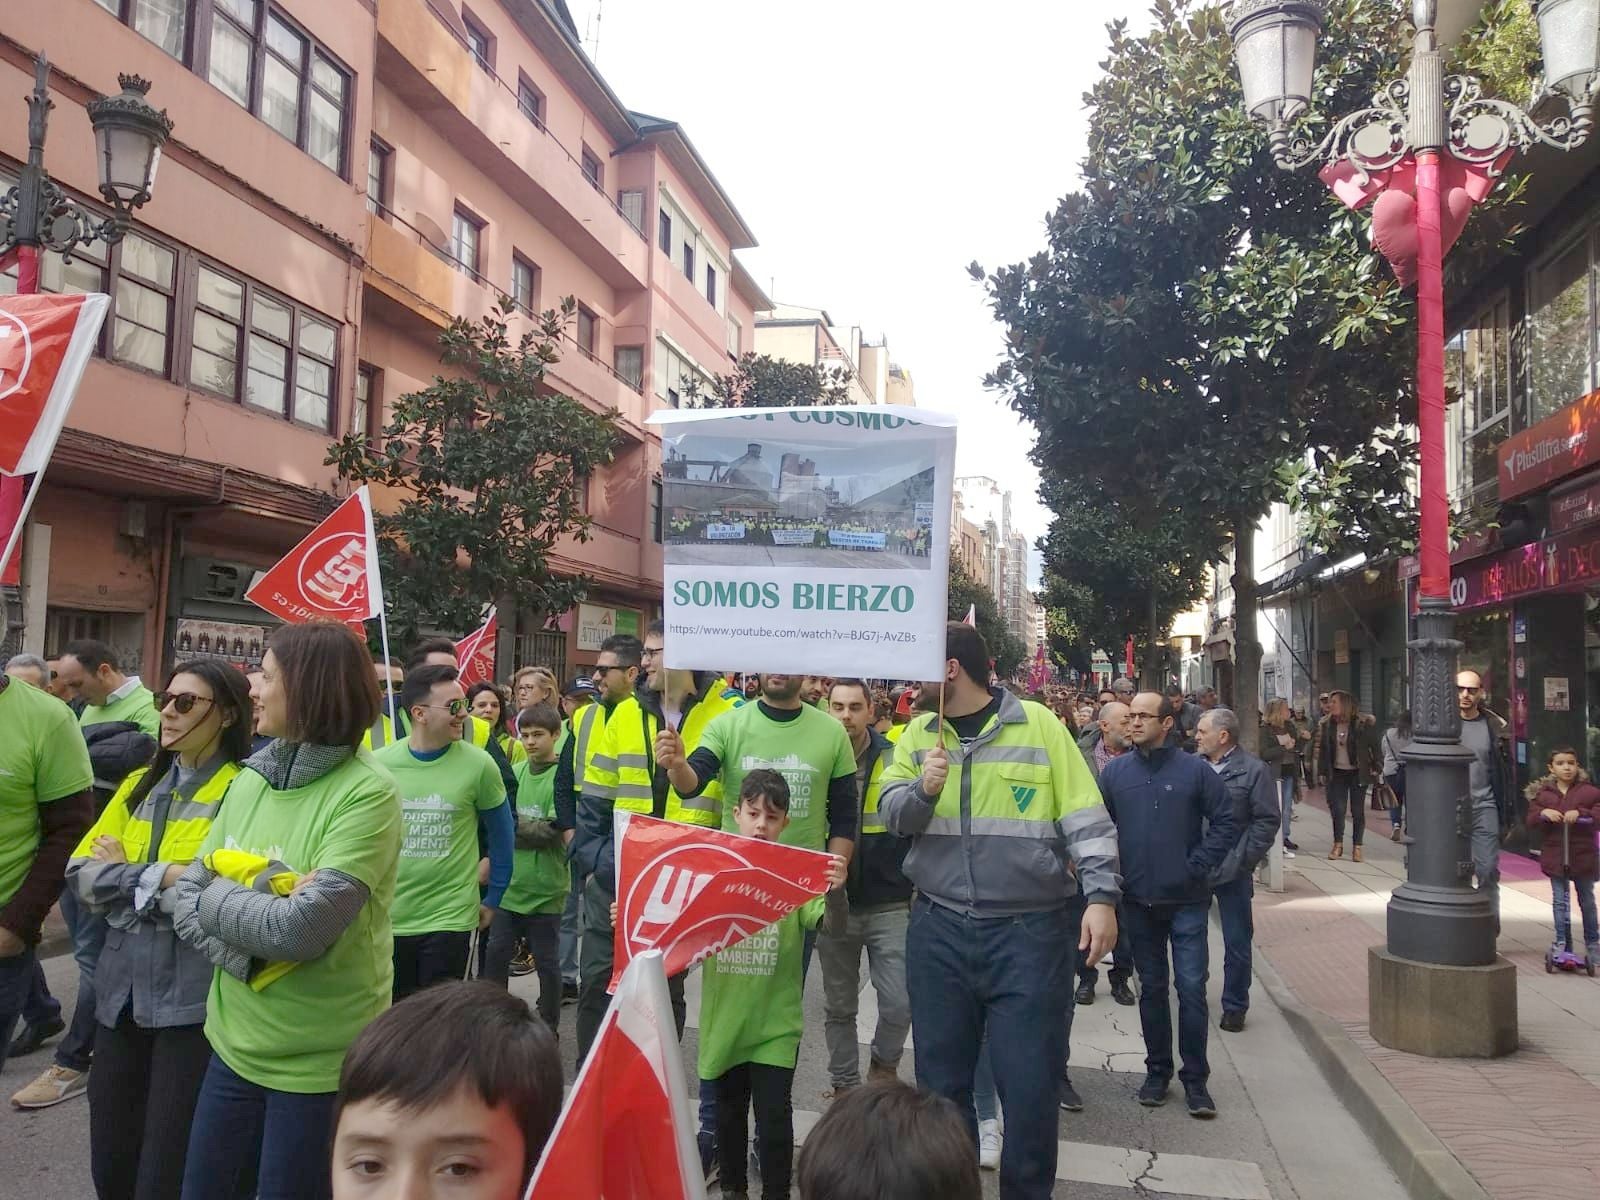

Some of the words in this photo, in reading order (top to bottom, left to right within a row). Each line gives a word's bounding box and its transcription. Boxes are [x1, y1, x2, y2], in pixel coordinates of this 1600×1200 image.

[673, 580, 780, 609] SOMOS
[793, 583, 915, 613] BIERZO
[1451, 577, 1467, 606] CO
[717, 950, 778, 966] AMBIENTE
